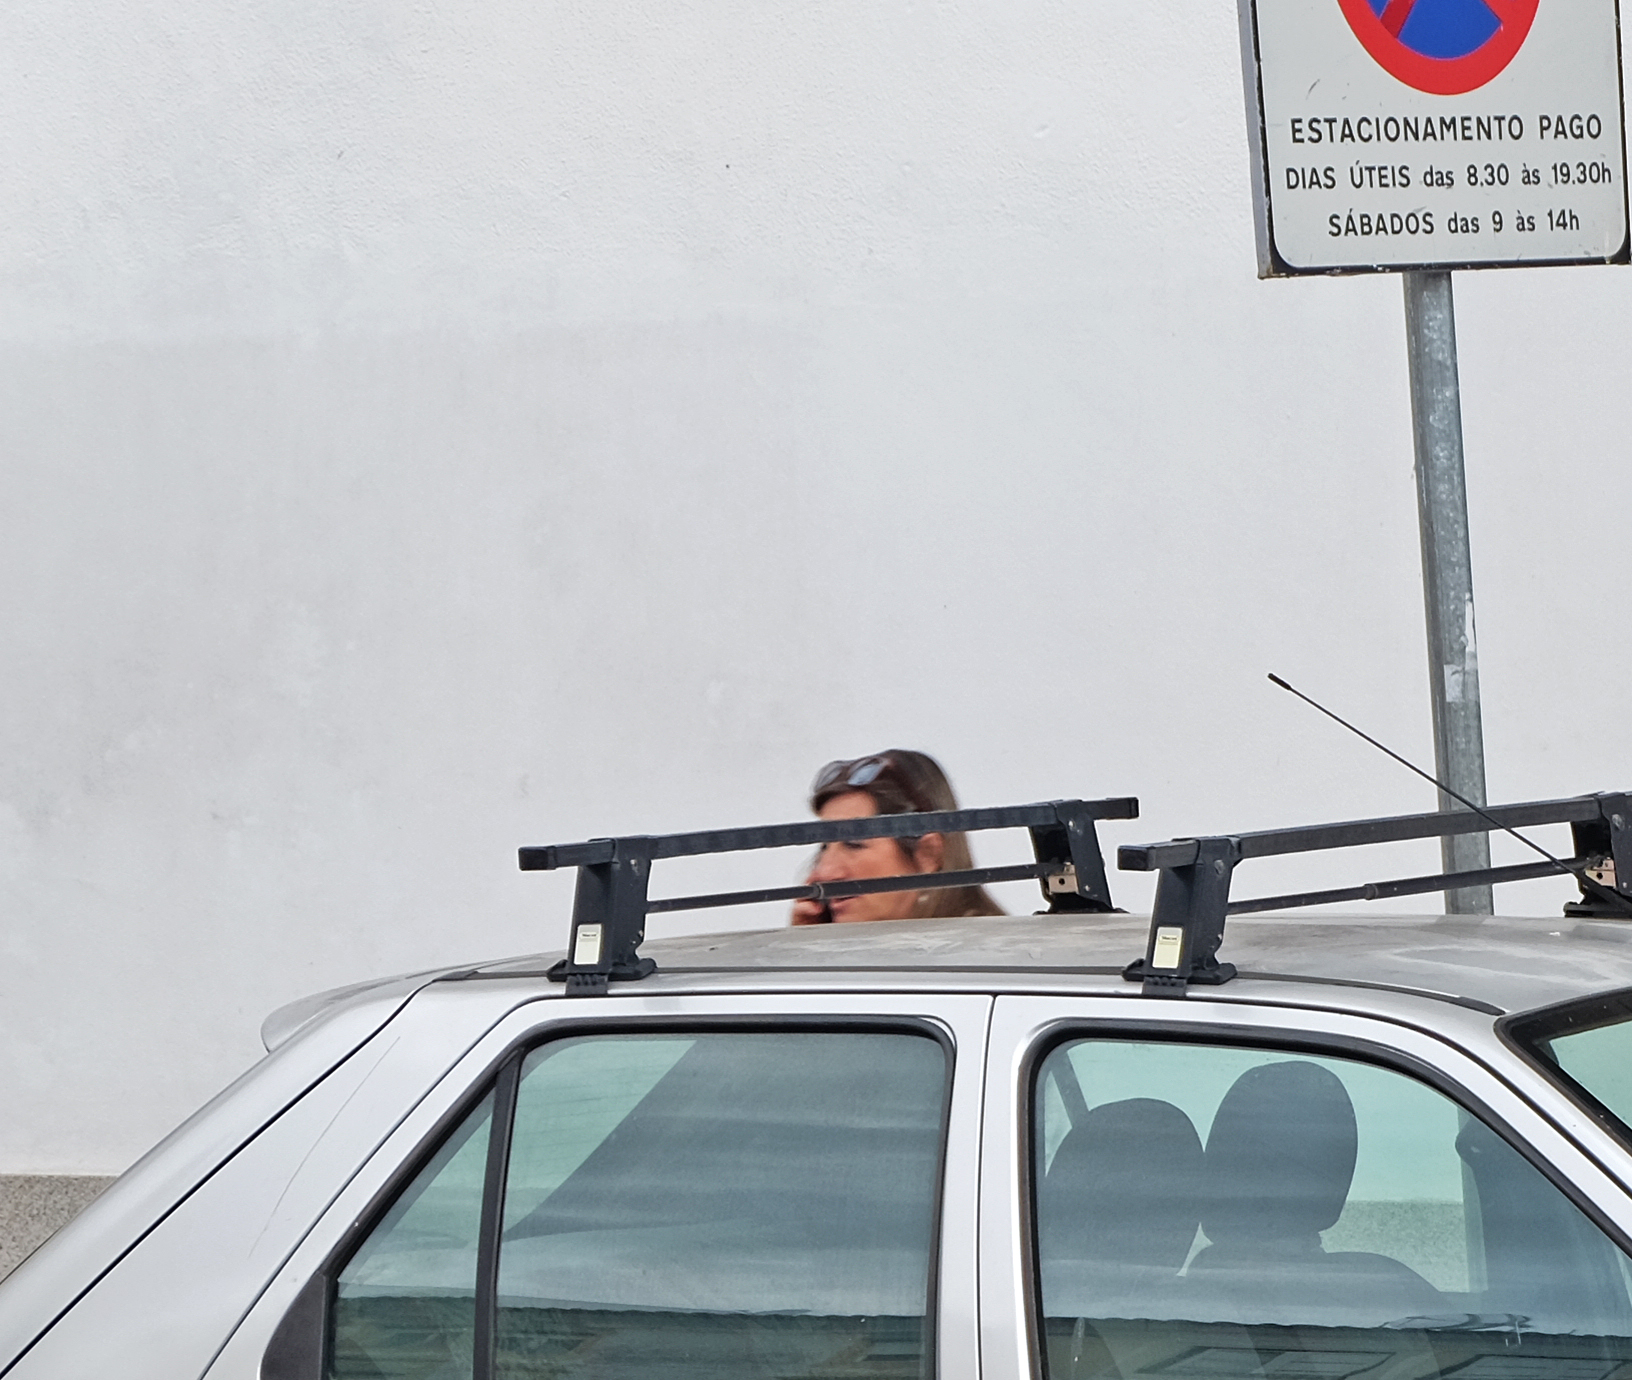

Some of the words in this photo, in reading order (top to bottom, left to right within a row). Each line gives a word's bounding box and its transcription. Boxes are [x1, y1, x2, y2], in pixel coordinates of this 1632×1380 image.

[1290, 114, 1525, 144] ESTACIONAMENTO
[1538, 113, 1603, 140] PAGO
[1285, 166, 1337, 190] DIAS
[1349, 159, 1412, 189] ÚTEIS
[1422, 164, 1455, 189] das
[1466, 163, 1511, 187] 8.30
[1521, 162, 1541, 186] às
[1551, 161, 1613, 185] 19.30h
[1328, 208, 1436, 237] SÁBADOS
[1447, 211, 1481, 234] das
[1491, 210, 1504, 233] 9
[1515, 209, 1537, 232] às
[1546, 208, 1581, 232] 14h
